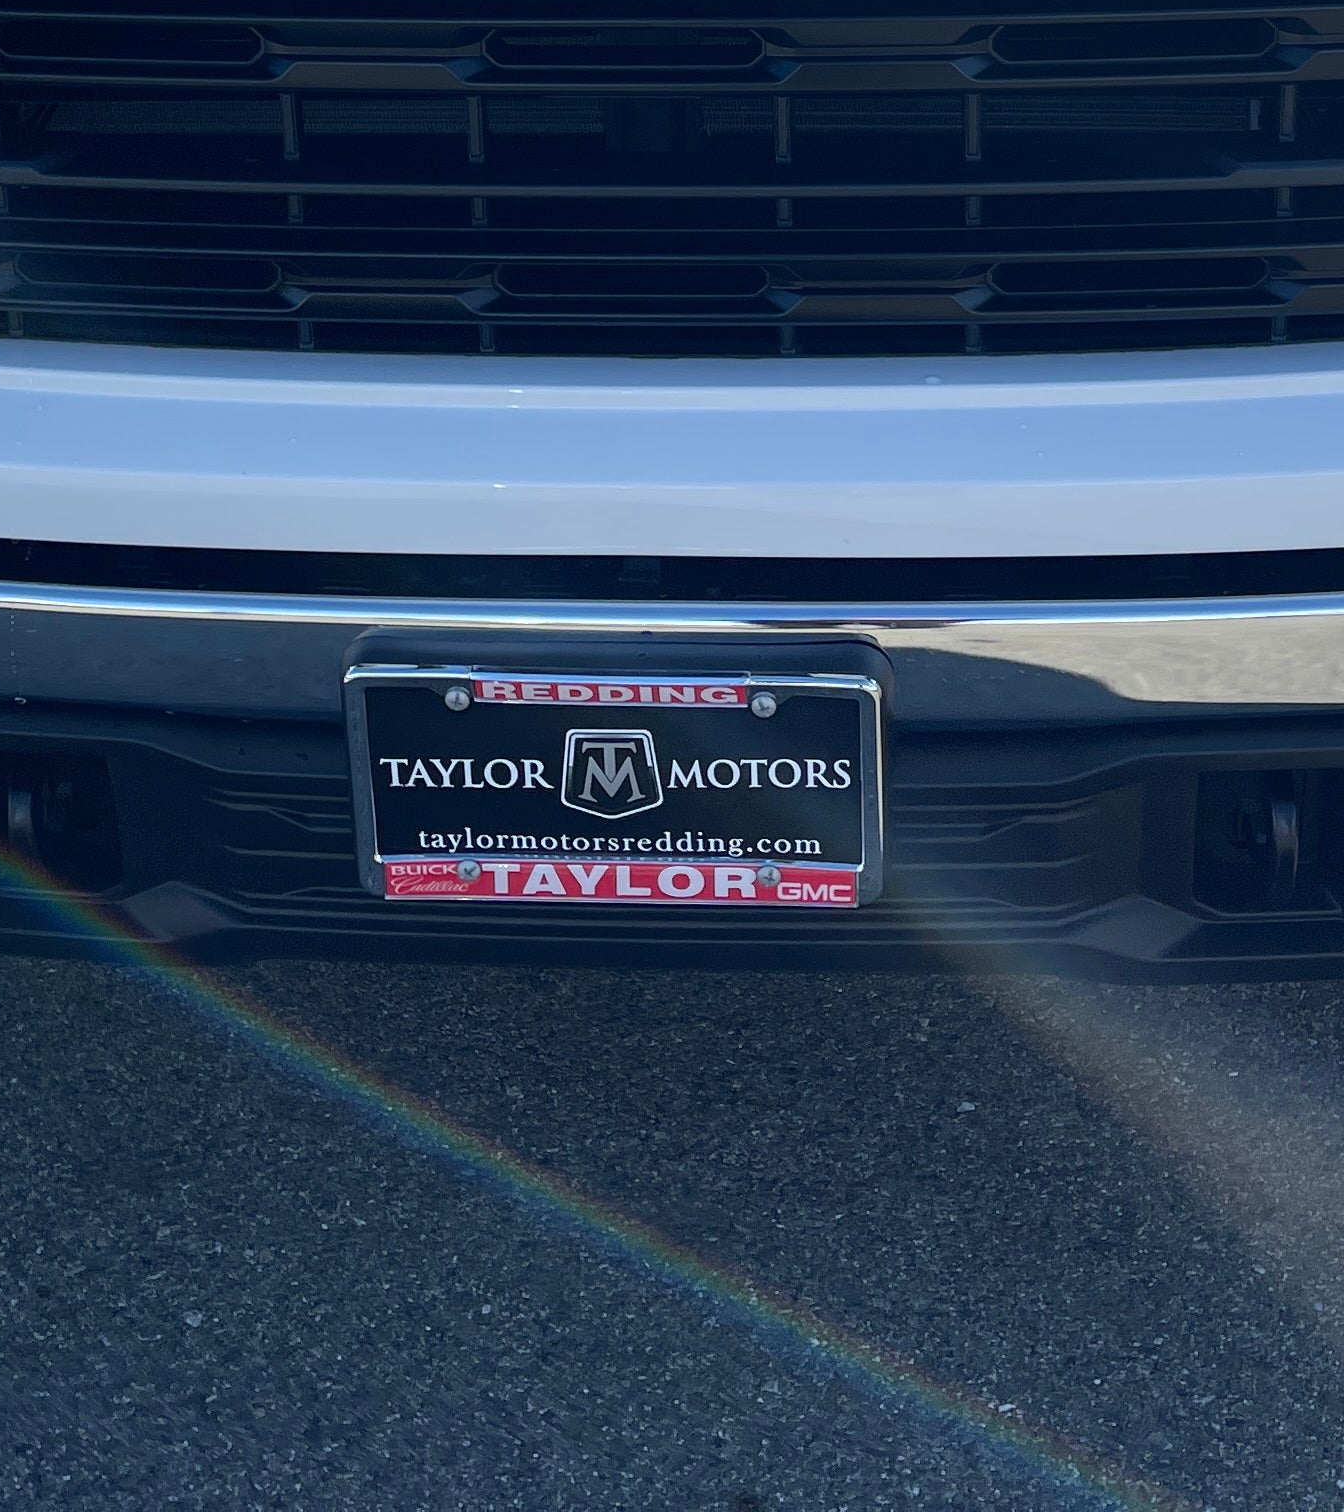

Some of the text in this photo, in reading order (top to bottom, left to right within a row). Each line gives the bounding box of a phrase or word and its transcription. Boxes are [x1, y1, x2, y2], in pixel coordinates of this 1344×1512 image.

[482, 680, 739, 704] REDDING
[379, 757, 555, 790] TAYLOR
[667, 758, 851, 790] MOTORS
[418, 827, 823, 857] taylormotorsredding.com
[390, 863, 457, 876] BUICK
[482, 862, 757, 898] TAYLOR
[776, 881, 853, 904] GMC
